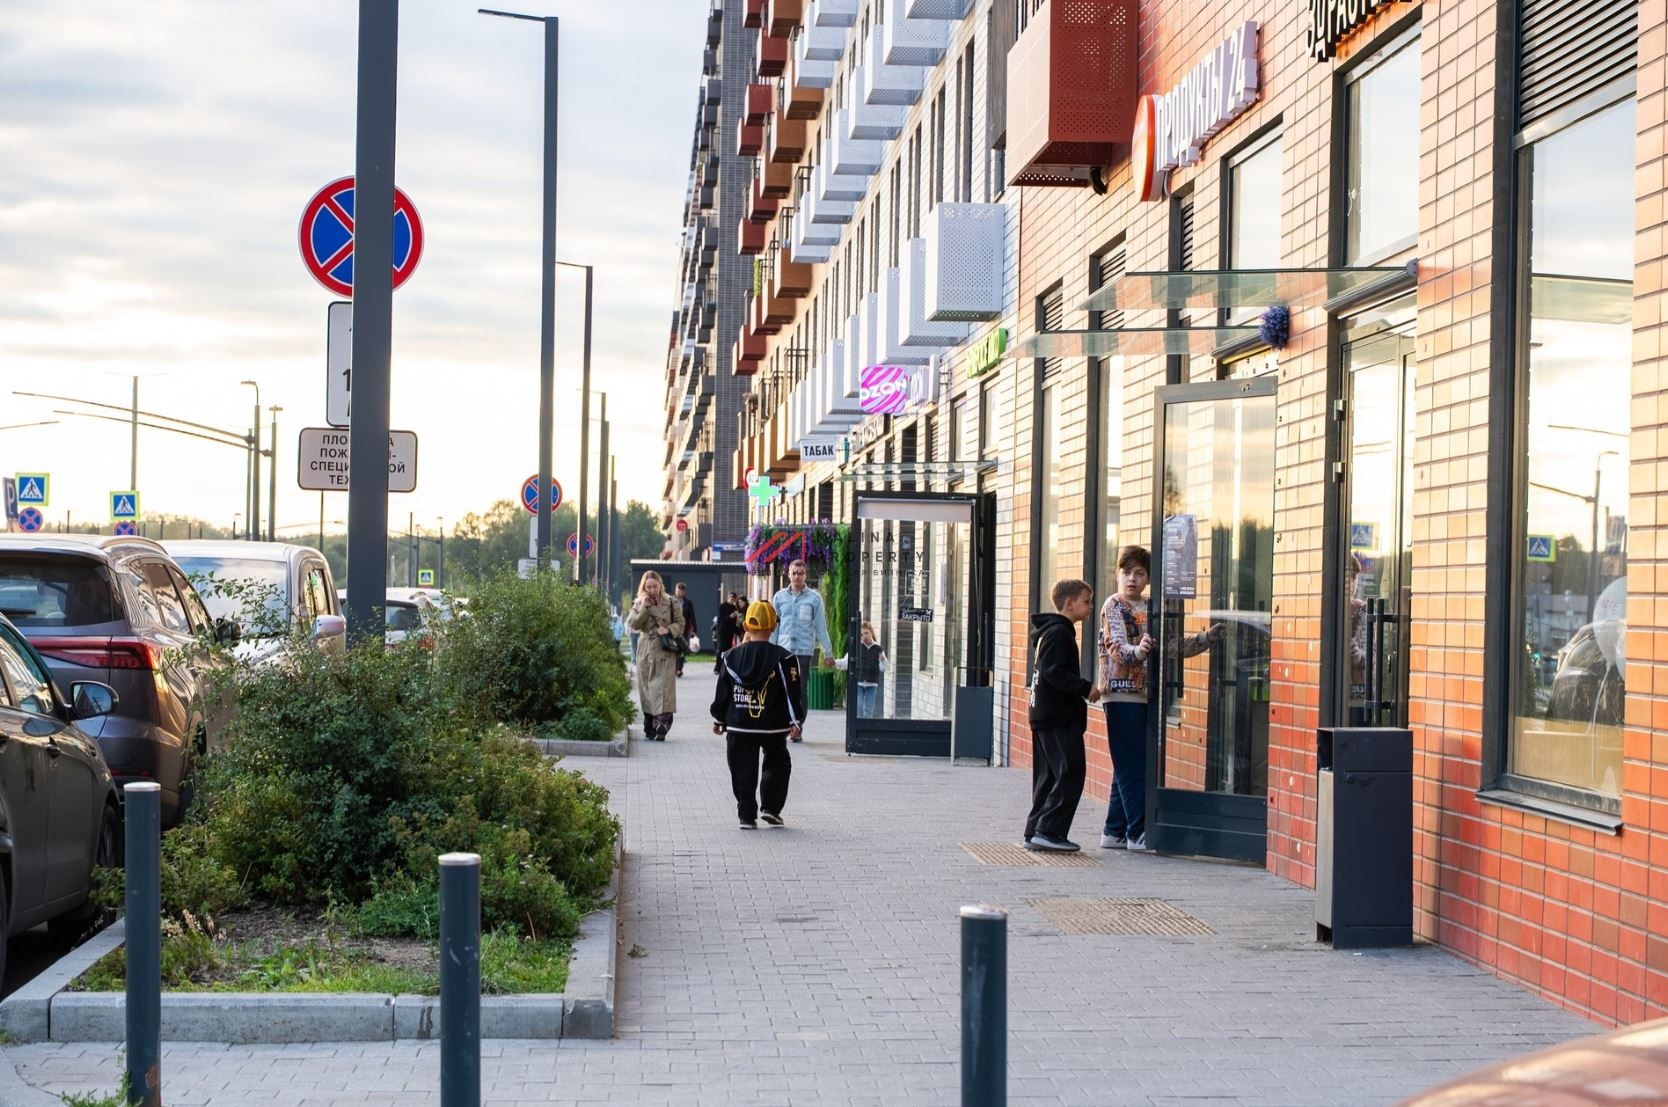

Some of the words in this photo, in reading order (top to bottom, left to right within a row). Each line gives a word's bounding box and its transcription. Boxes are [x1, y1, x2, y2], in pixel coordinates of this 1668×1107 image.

[1157, 40, 1227, 172] ПРОДУКТЫ
[1227, 21, 1250, 113] 24
[861, 379, 907, 401] OZON
[803, 445, 834, 457] ТАБАК
